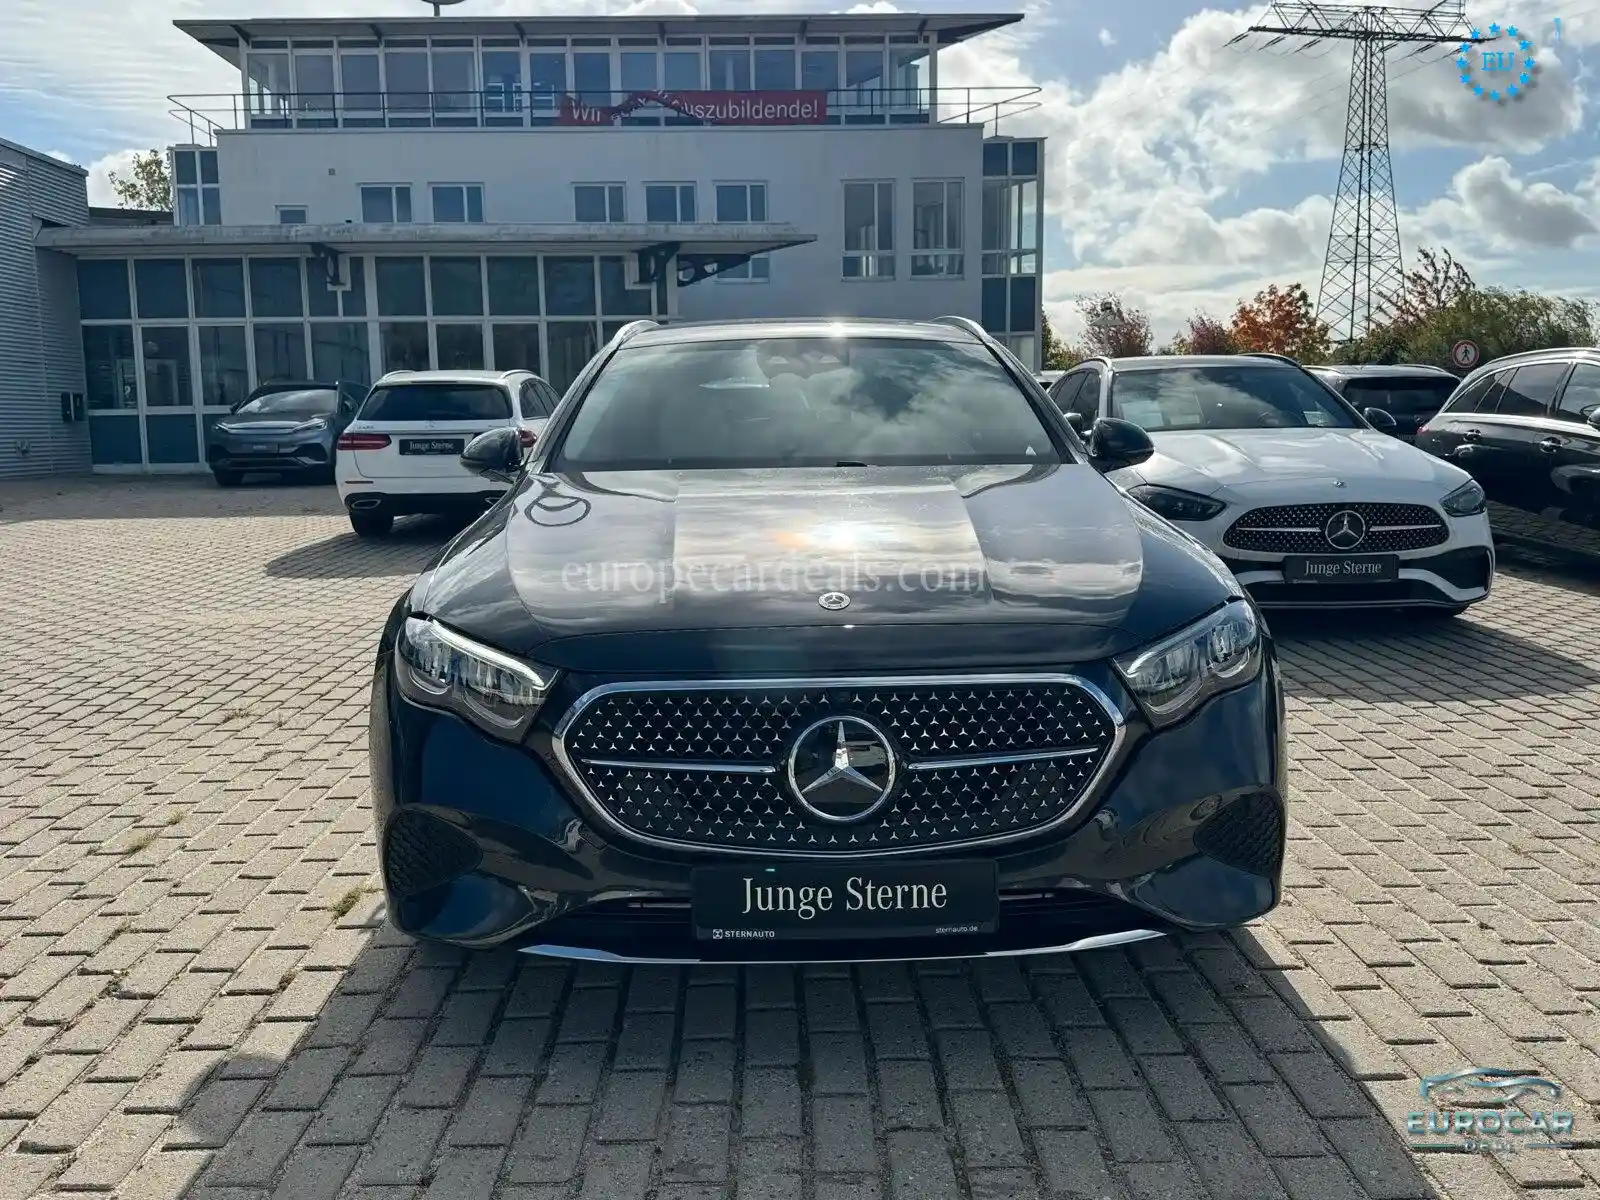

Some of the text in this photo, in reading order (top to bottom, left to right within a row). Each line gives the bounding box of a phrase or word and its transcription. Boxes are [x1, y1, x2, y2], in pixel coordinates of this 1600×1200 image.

[1304, 560, 1382, 577] Junge Sterne
[742, 876, 947, 920] Junge Sterne
[724, 930, 776, 939] STERNAUTO
[935, 925, 979, 934] sternauto.de
